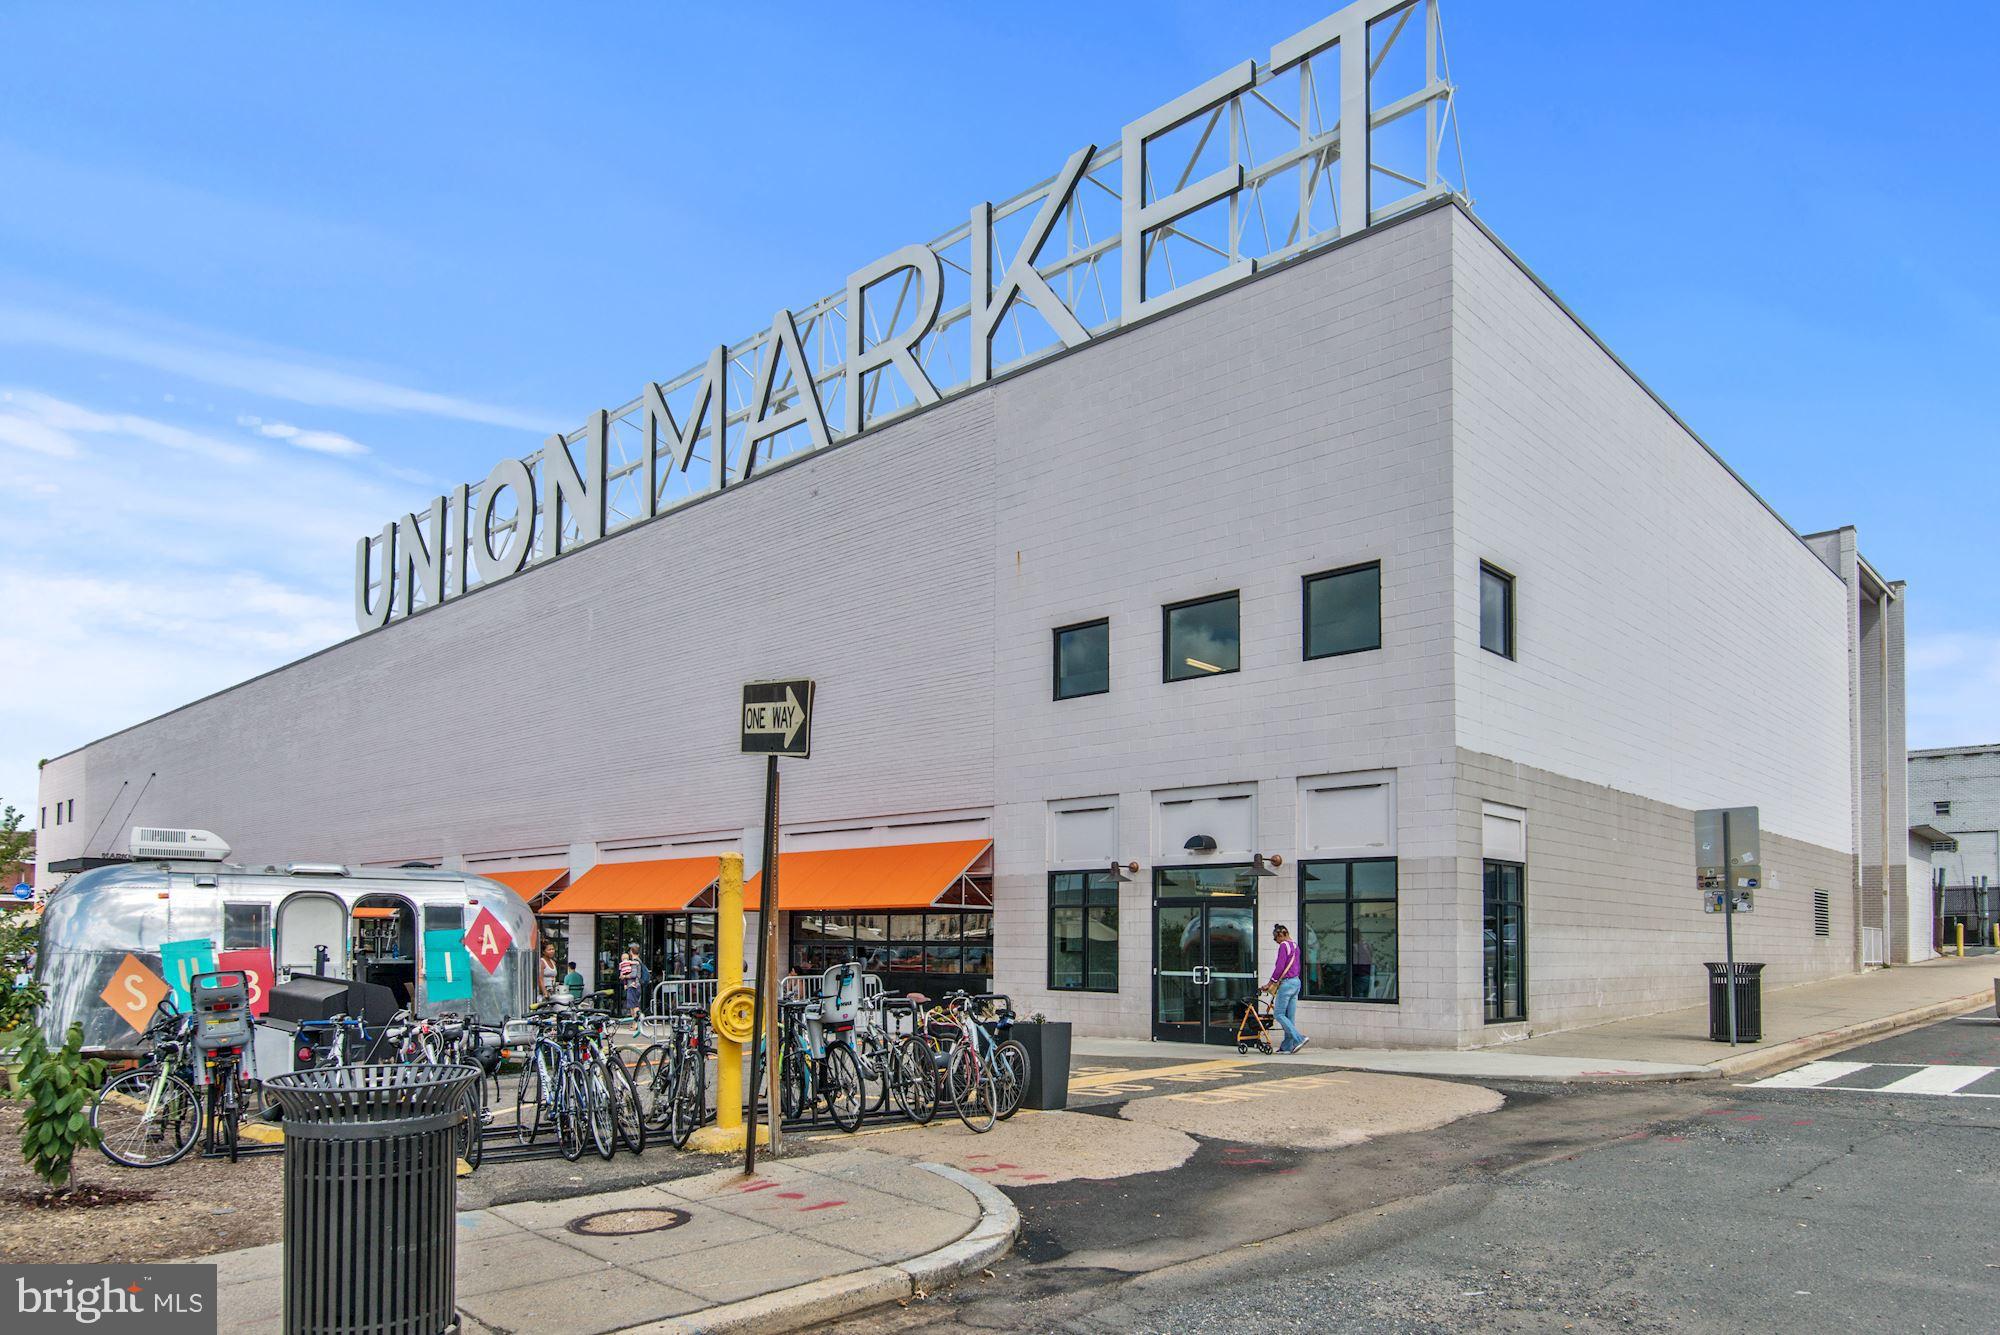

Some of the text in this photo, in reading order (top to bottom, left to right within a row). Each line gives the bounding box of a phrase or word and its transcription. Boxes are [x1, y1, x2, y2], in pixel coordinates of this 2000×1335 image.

[355, 0, 1420, 635] UNION MARKET
[746, 706, 795, 729] ONE WAY
